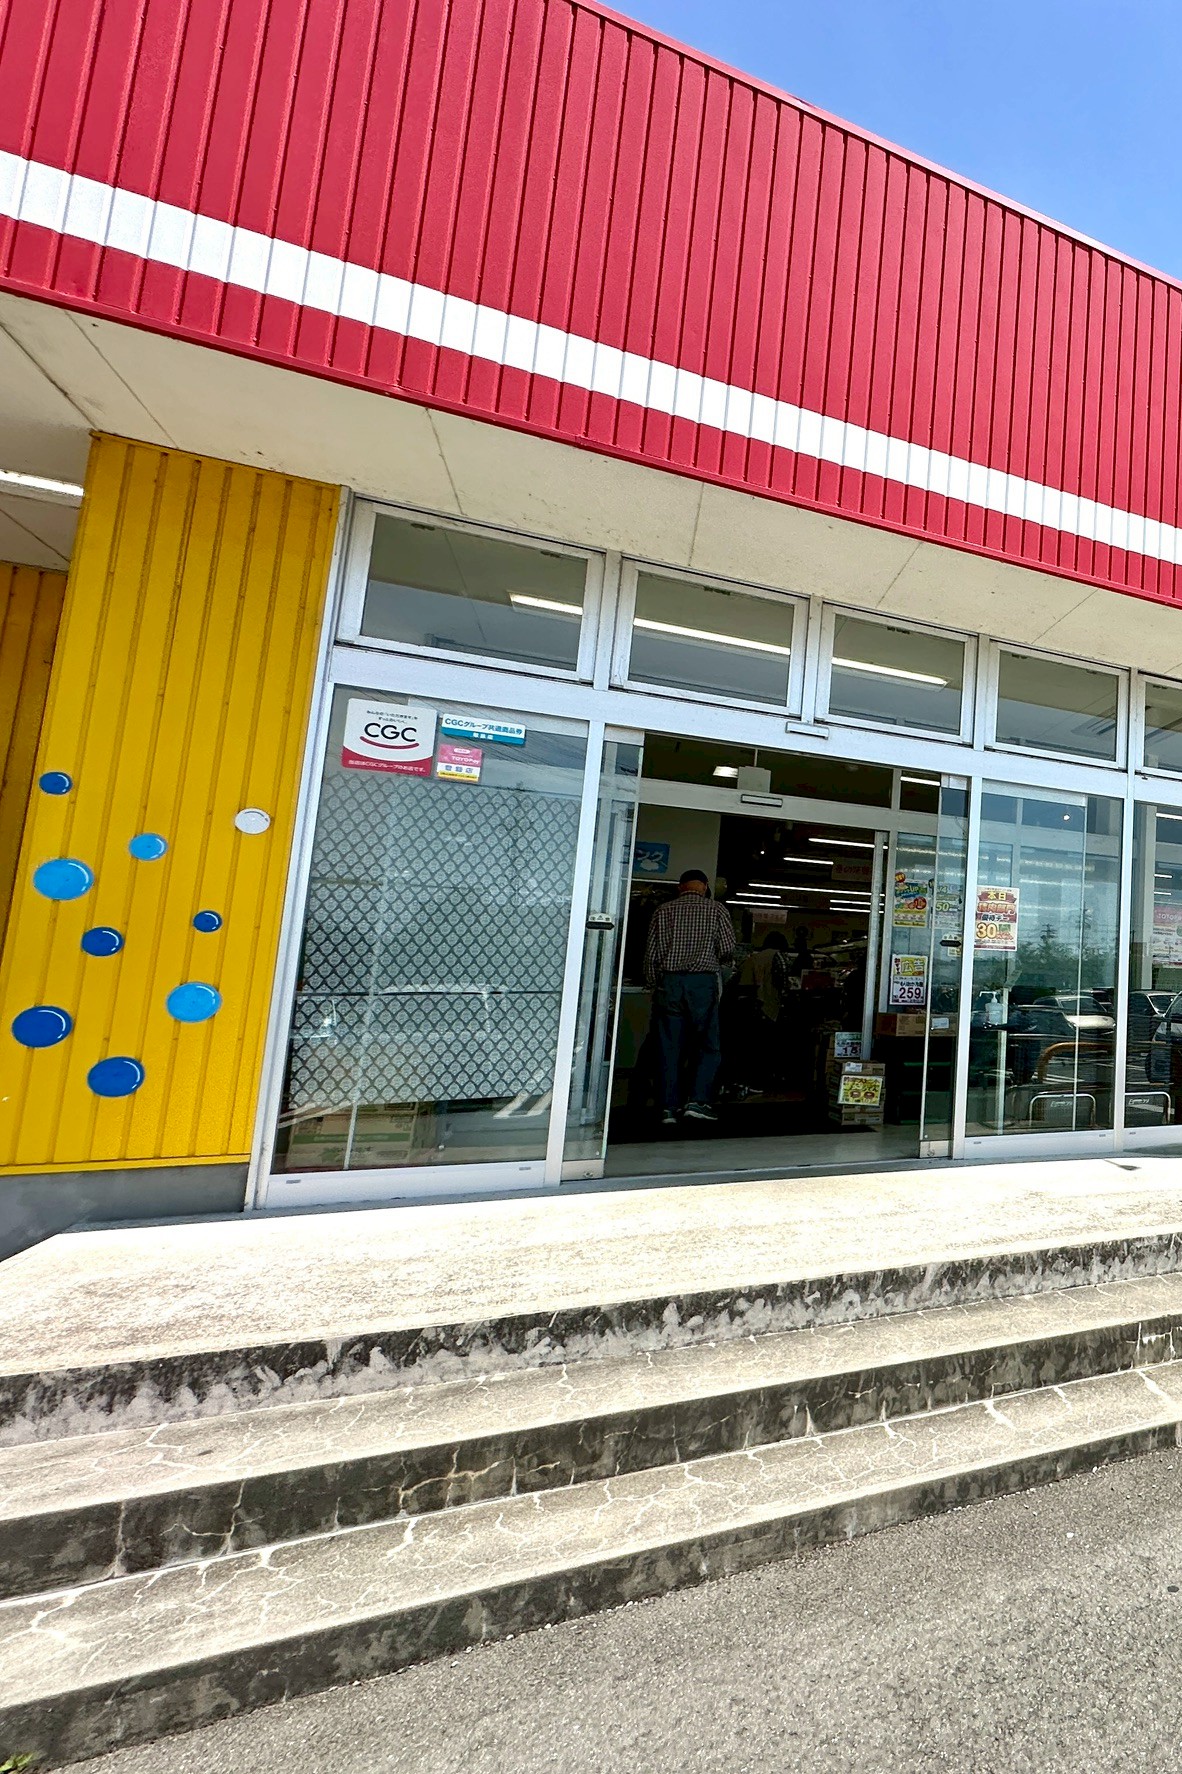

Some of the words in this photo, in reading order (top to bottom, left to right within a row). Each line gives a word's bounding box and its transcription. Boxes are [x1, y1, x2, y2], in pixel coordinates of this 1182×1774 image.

[363, 722, 417, 743] CGC
[987, 891, 1007, 901] 本日
[976, 922, 998, 939] 30
[899, 987, 922, 999] 259
